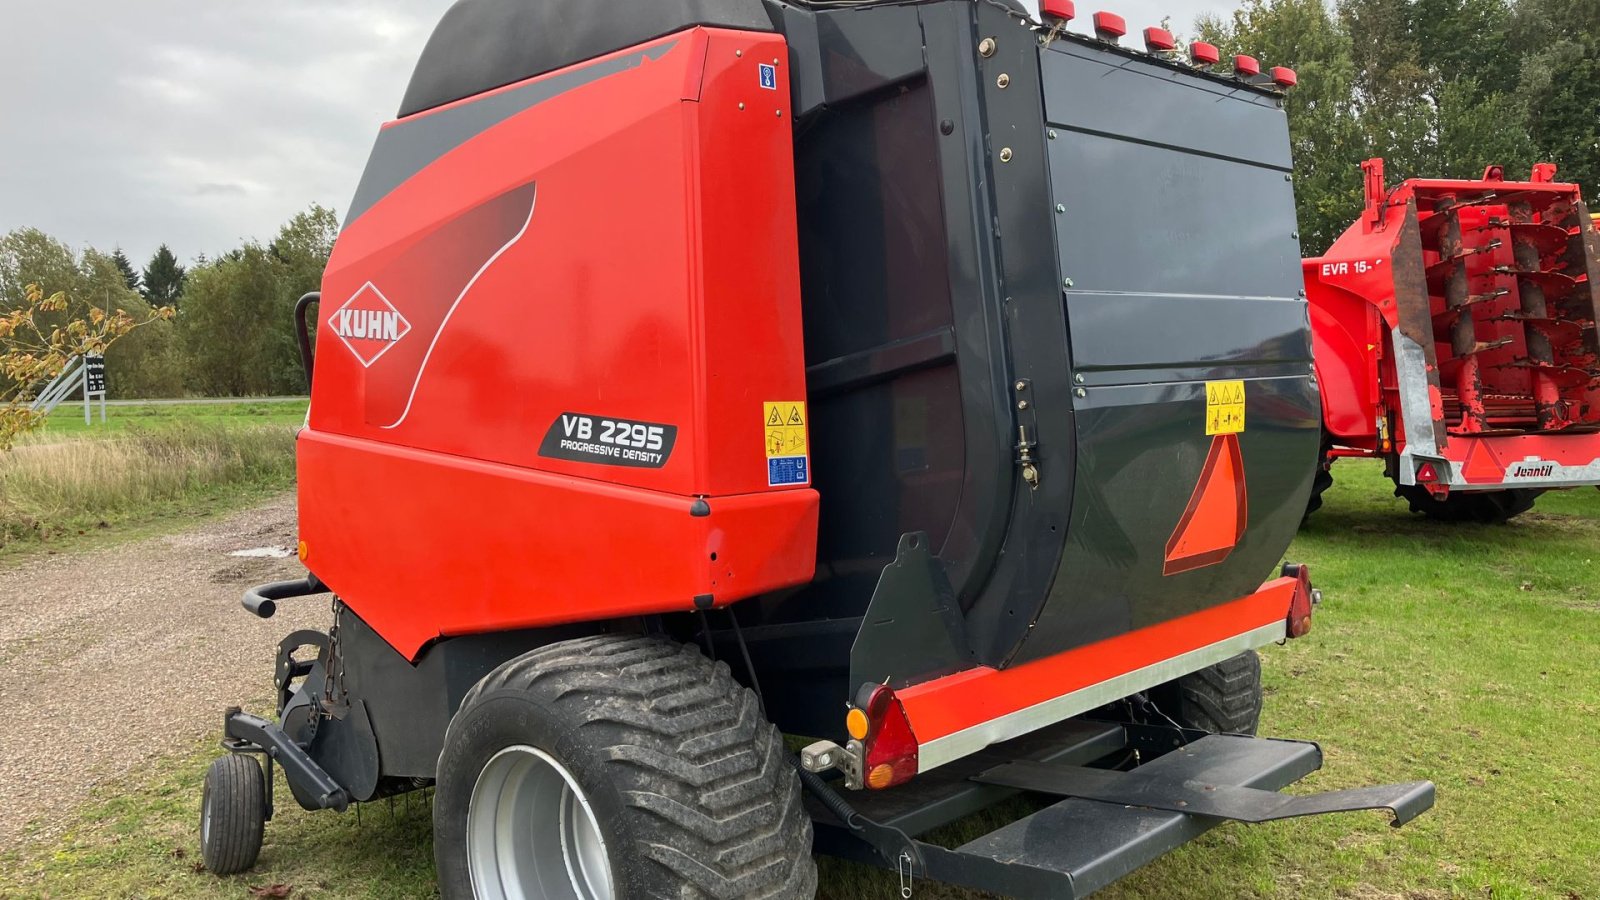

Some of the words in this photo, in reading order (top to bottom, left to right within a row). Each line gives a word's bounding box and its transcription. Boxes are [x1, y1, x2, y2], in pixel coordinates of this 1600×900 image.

[1322, 262, 1349, 276] EVR
[339, 308, 399, 341] KUHN
[562, 414, 593, 440] VB
[599, 420, 664, 451] 2295
[560, 439, 620, 457] PROGRESSIVE
[622, 448, 662, 463] DENSITY
[1513, 465, 1553, 477] Jeantil
